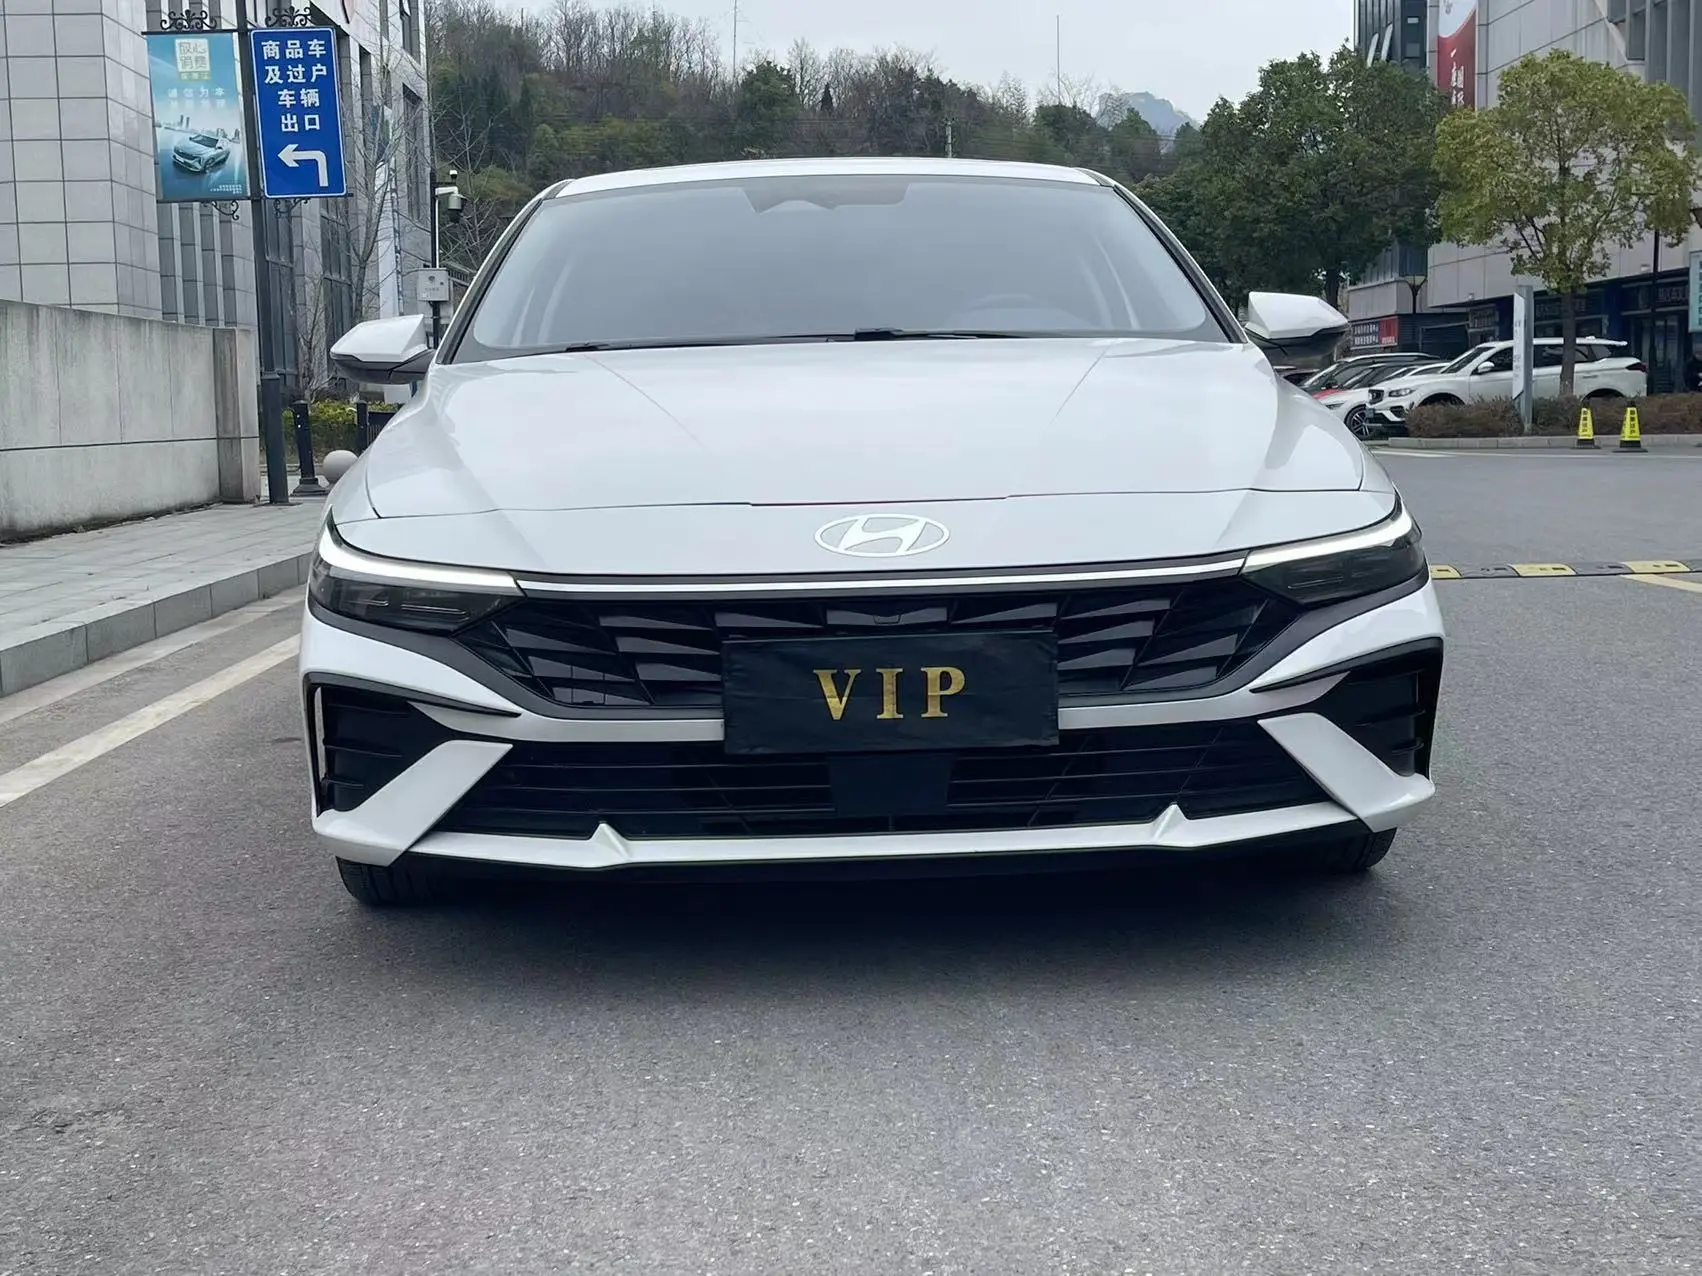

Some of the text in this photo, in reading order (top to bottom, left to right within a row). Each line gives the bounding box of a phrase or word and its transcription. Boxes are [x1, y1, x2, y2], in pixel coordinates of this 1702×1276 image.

[262, 39, 326, 60] 商品车
[264, 64, 327, 84] 及过户
[278, 88, 320, 109] 车辆
[281, 114, 321, 133] 出口
[813, 666, 966, 721] VIP
